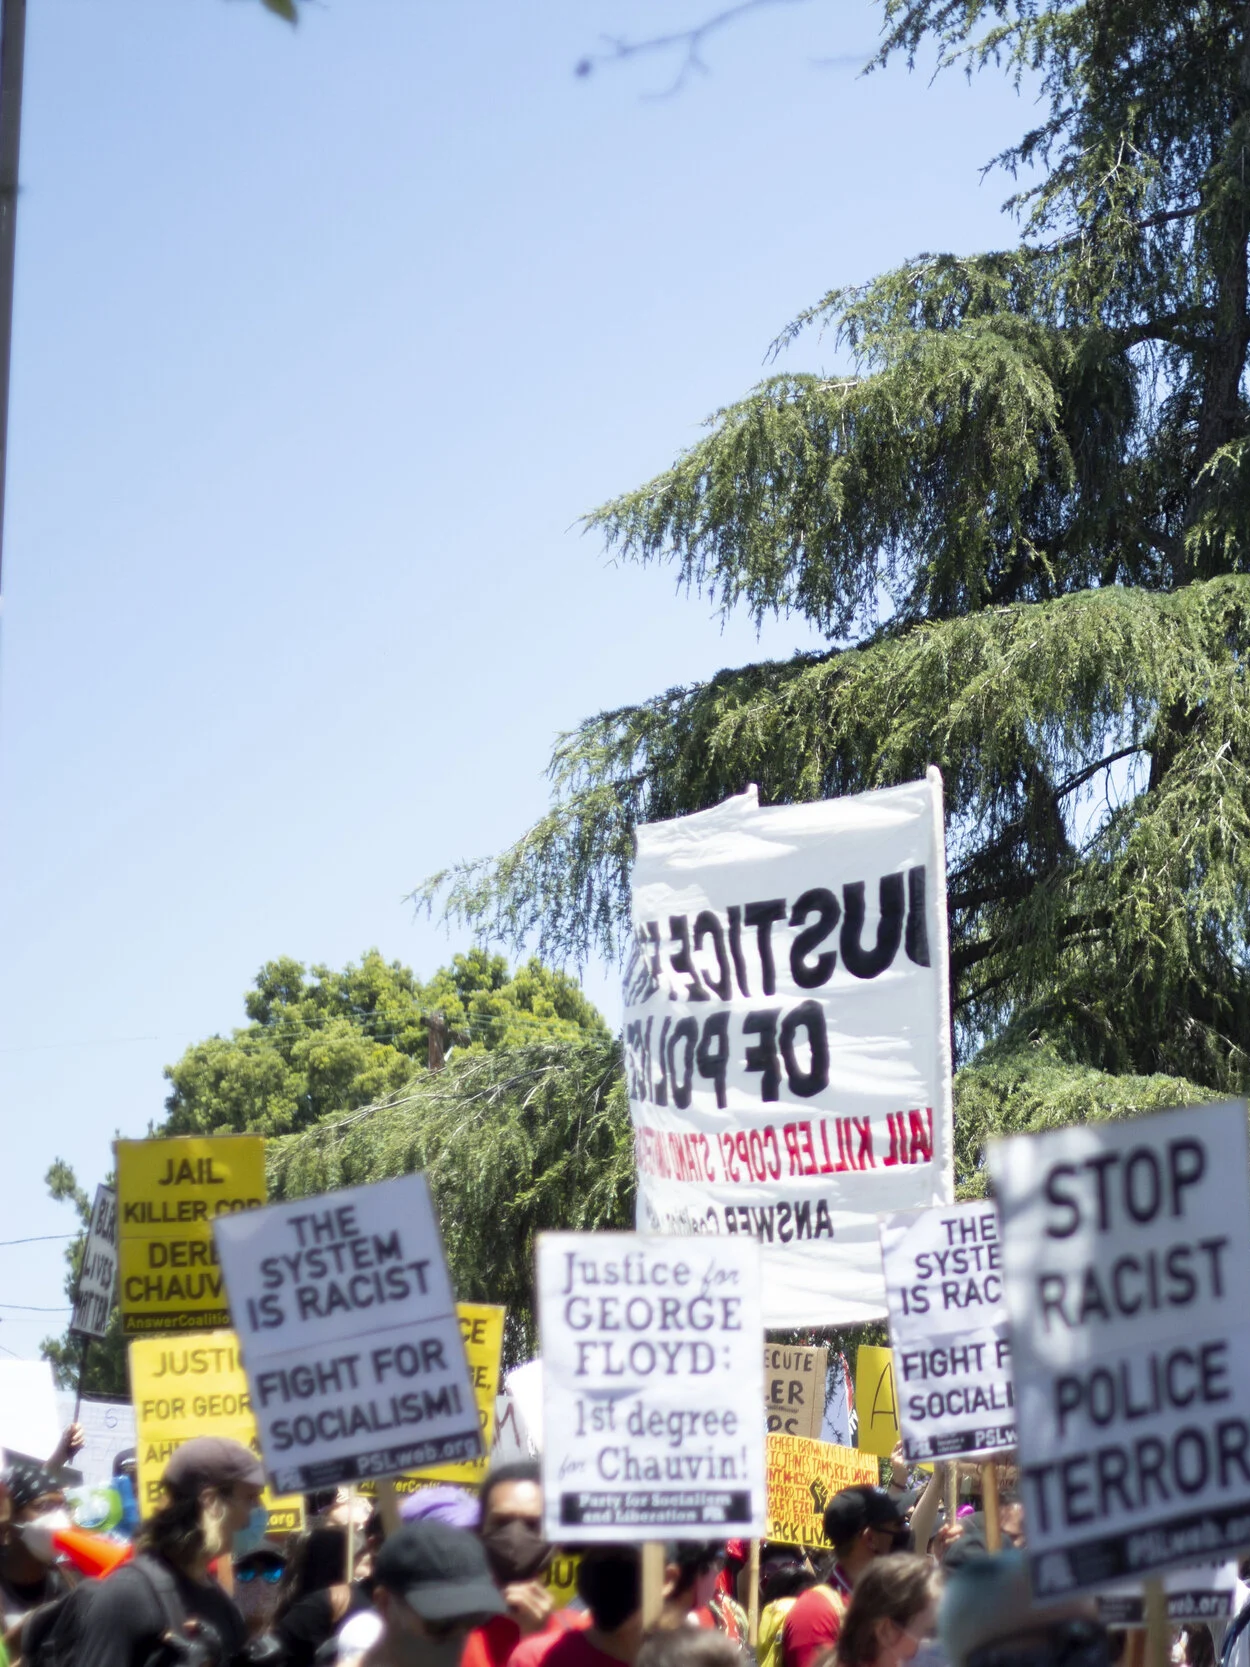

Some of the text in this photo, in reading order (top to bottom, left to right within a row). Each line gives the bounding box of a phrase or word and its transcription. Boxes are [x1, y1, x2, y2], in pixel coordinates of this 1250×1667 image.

[159, 1158, 225, 1186] JAIL
[1045, 1137, 1207, 1240] STOP
[123, 1201, 208, 1224] KILLER
[287, 1205, 360, 1248] THE
[941, 1213, 998, 1246] THE
[259, 1229, 404, 1290] SYSTEM
[562, 1251, 742, 1298] Justice for
[915, 1243, 1002, 1280] SYSTE
[124, 1273, 223, 1302] CHAUV
[246, 1259, 431, 1333] IS RACIST
[901, 1274, 1002, 1316] IS RAC
[1037, 1235, 1229, 1332] RACIST
[563, 1295, 743, 1332] GEORGE
[151, 1346, 242, 1378] JUSTI
[255, 1338, 448, 1408] FIGHT FOR
[573, 1340, 733, 1376] FLOYD:
[901, 1343, 987, 1383] FIGHT
[766, 1379, 805, 1405] ER
[1055, 1338, 1231, 1438] POLICE
[142, 1394, 252, 1423] FOR GEOR
[269, 1383, 464, 1452] SOCIALISM!
[574, 1399, 739, 1448] 1st degree
[557, 1455, 587, 1481] for
[596, 1445, 749, 1483] Chauvin!
[767, 1520, 800, 1542] ACK
